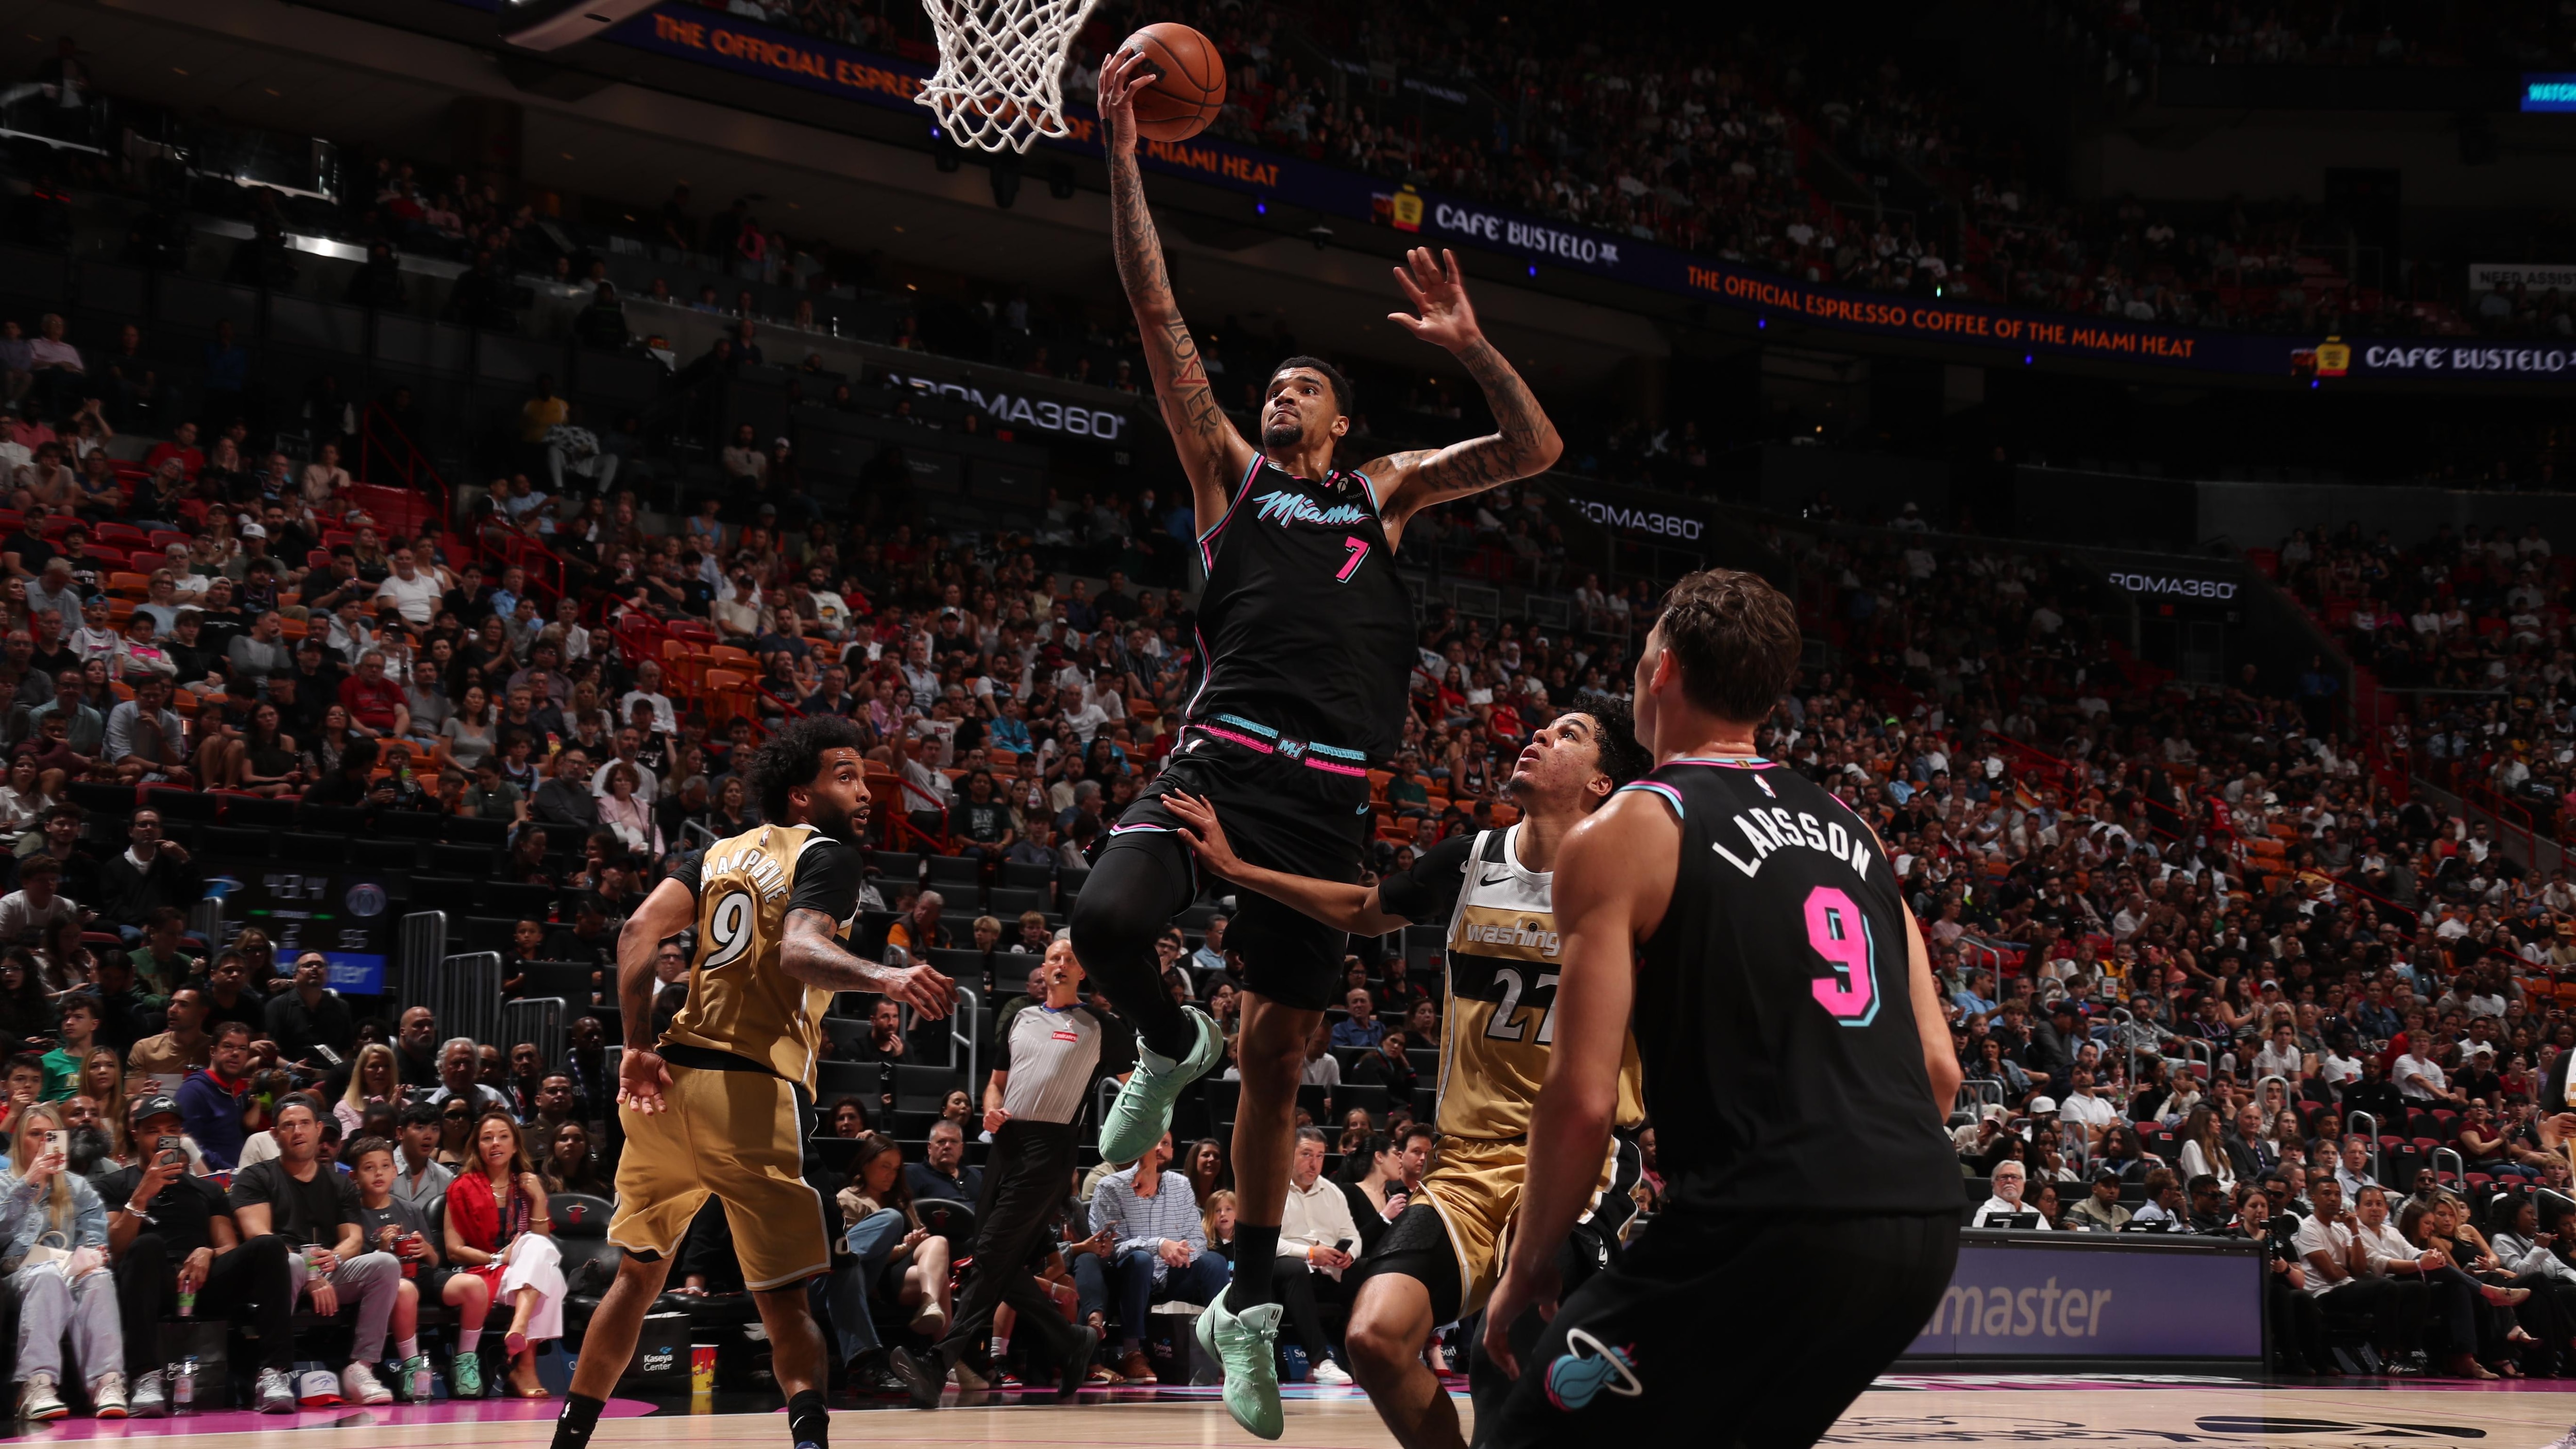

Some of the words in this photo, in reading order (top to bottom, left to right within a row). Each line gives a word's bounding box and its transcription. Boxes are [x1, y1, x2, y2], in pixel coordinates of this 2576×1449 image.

[652, 13, 707, 50] THE
[710, 28, 831, 81] OFFICIAL
[1062, 115, 1094, 143] OF
[1145, 139, 1218, 174] MIAMI
[1222, 152, 1280, 187] HEAT
[1506, 220, 1597, 263] BUSTELO
[2479, 270, 2522, 283] NEED
[1687, 265, 1721, 293] THE
[1724, 275, 1802, 311] OFFICIAL
[1805, 293, 1907, 326] ESPRESSO
[1912, 308, 1990, 336] COFFEE
[1994, 317, 2023, 340] OF
[2027, 320, 2067, 345] THE
[2071, 327, 2136, 353] MIAMI
[2141, 333, 2195, 359] HEAT
[2452, 347, 2567, 372] BUSTELO
[1252, 490, 1376, 529] Miami
[1335, 535, 1371, 584] 7
[1712, 807, 1871, 882] LARSSON
[702, 890, 753, 969] 9
[1804, 885, 1880, 1027] 9
[1485, 966, 1558, 1045] 27
[1052, 1032, 1077, 1041] Emirates
[643, 1354, 672, 1365] Kaseya
[643, 1363, 672, 1372] Center
